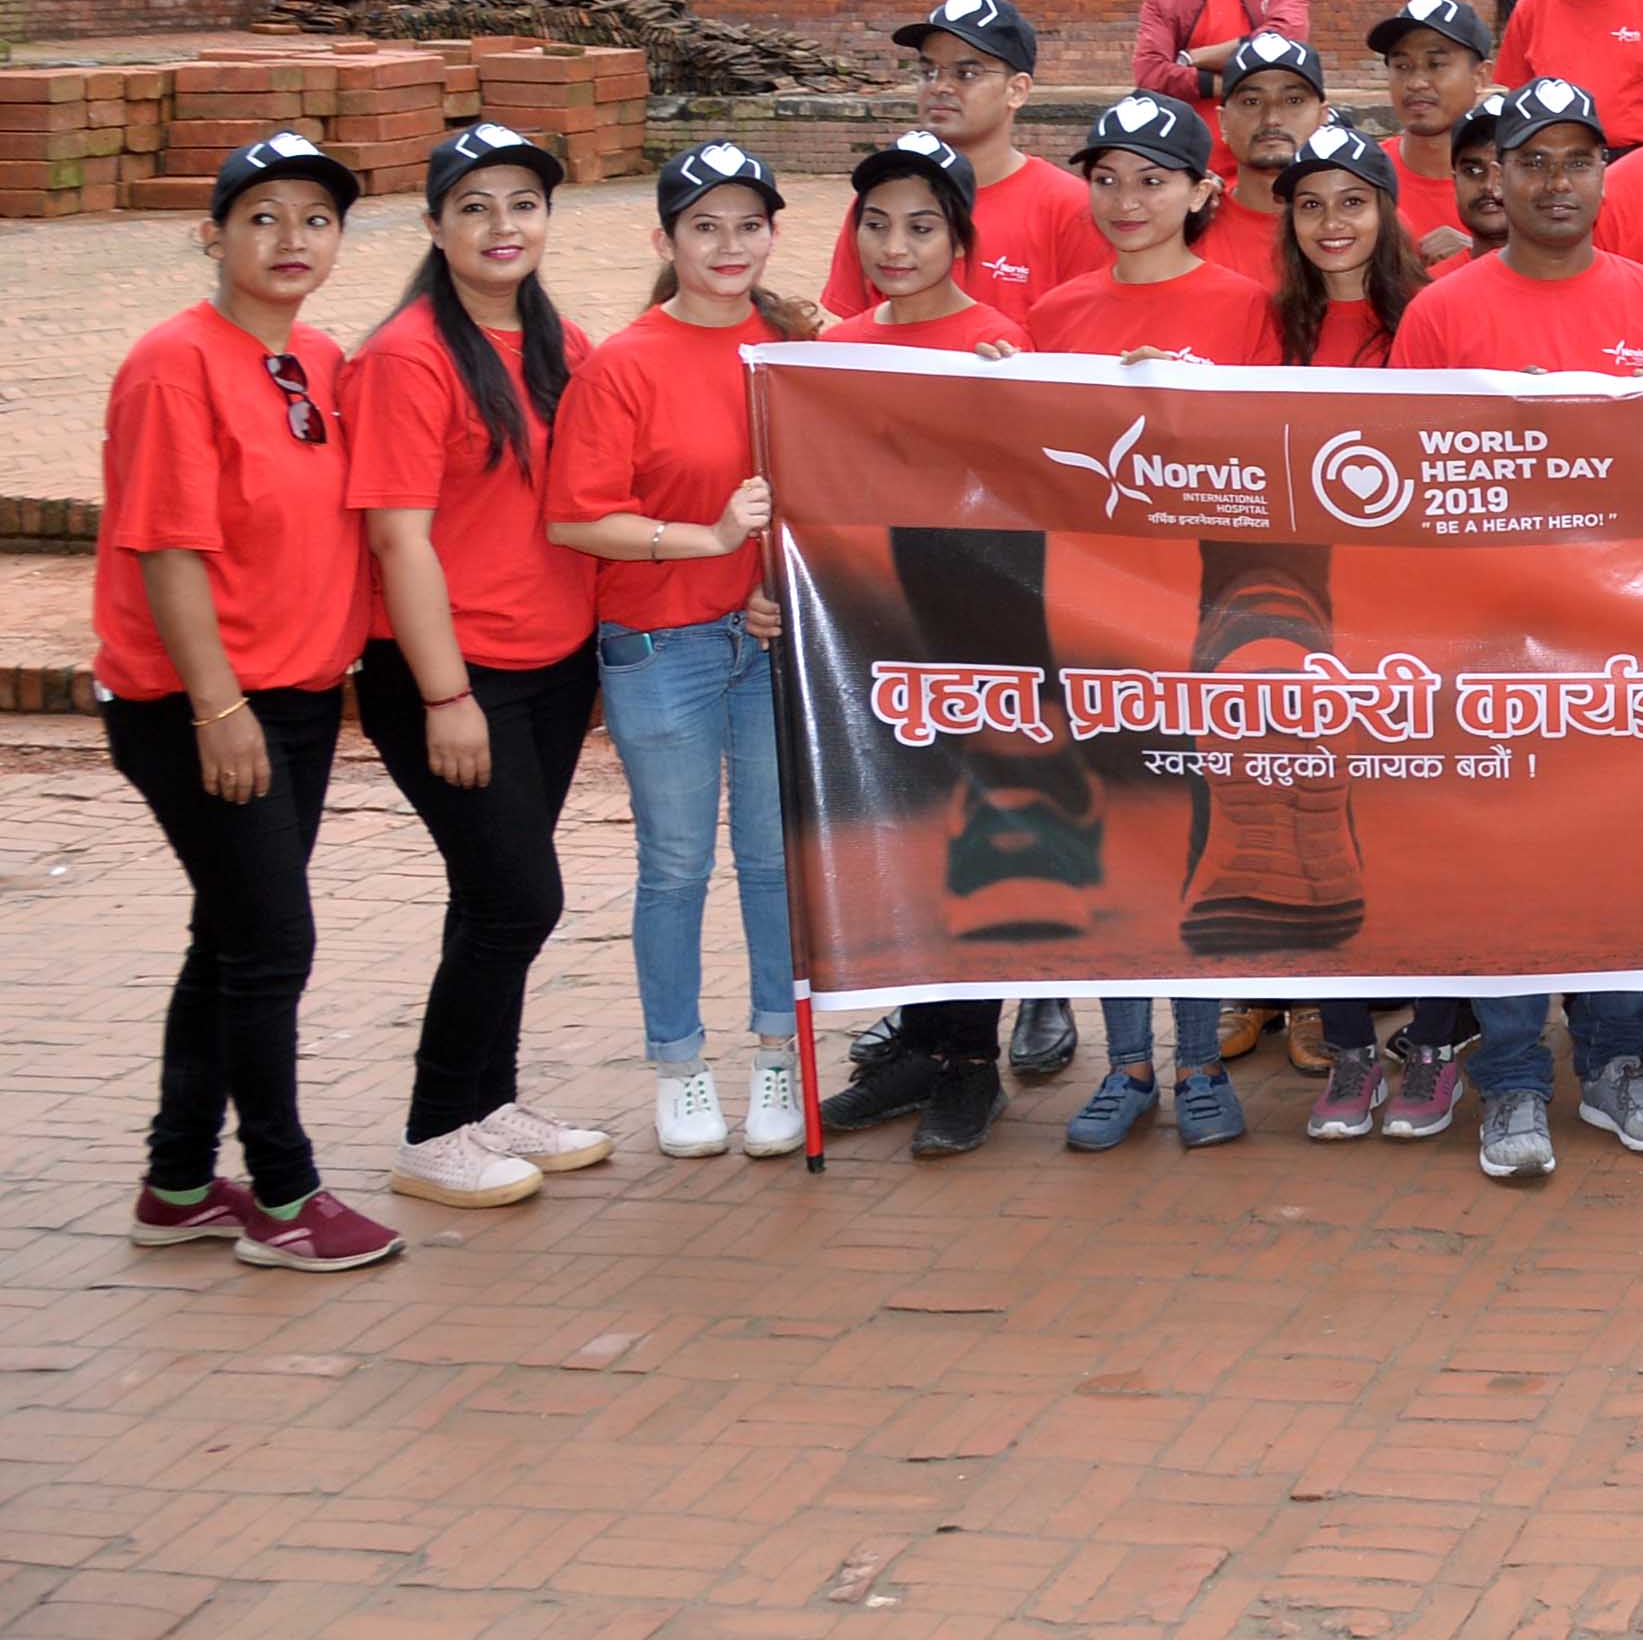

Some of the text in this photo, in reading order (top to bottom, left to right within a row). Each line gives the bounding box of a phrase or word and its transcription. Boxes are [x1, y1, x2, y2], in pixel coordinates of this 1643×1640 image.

[1419, 430, 1548, 454] WORLD
[1133, 455, 1267, 491] Norvic
[1421, 458, 1613, 483] HEART DAY
[1183, 492, 1268, 505] INTERNATIONAL
[1216, 503, 1268, 515] HOSPITAL
[1424, 486, 1508, 515] 2019
[1464, 520, 1478, 533] A
[1483, 516, 1543, 532] HEART
[1060, 652, 1440, 742] प्रभातफेरी
[1142, 749, 1233, 777] स्वस्थ
[1243, 745, 1337, 786] मुटुको
[1346, 754, 1445, 779] नायक
[1455, 744, 1513, 779] बनौं
